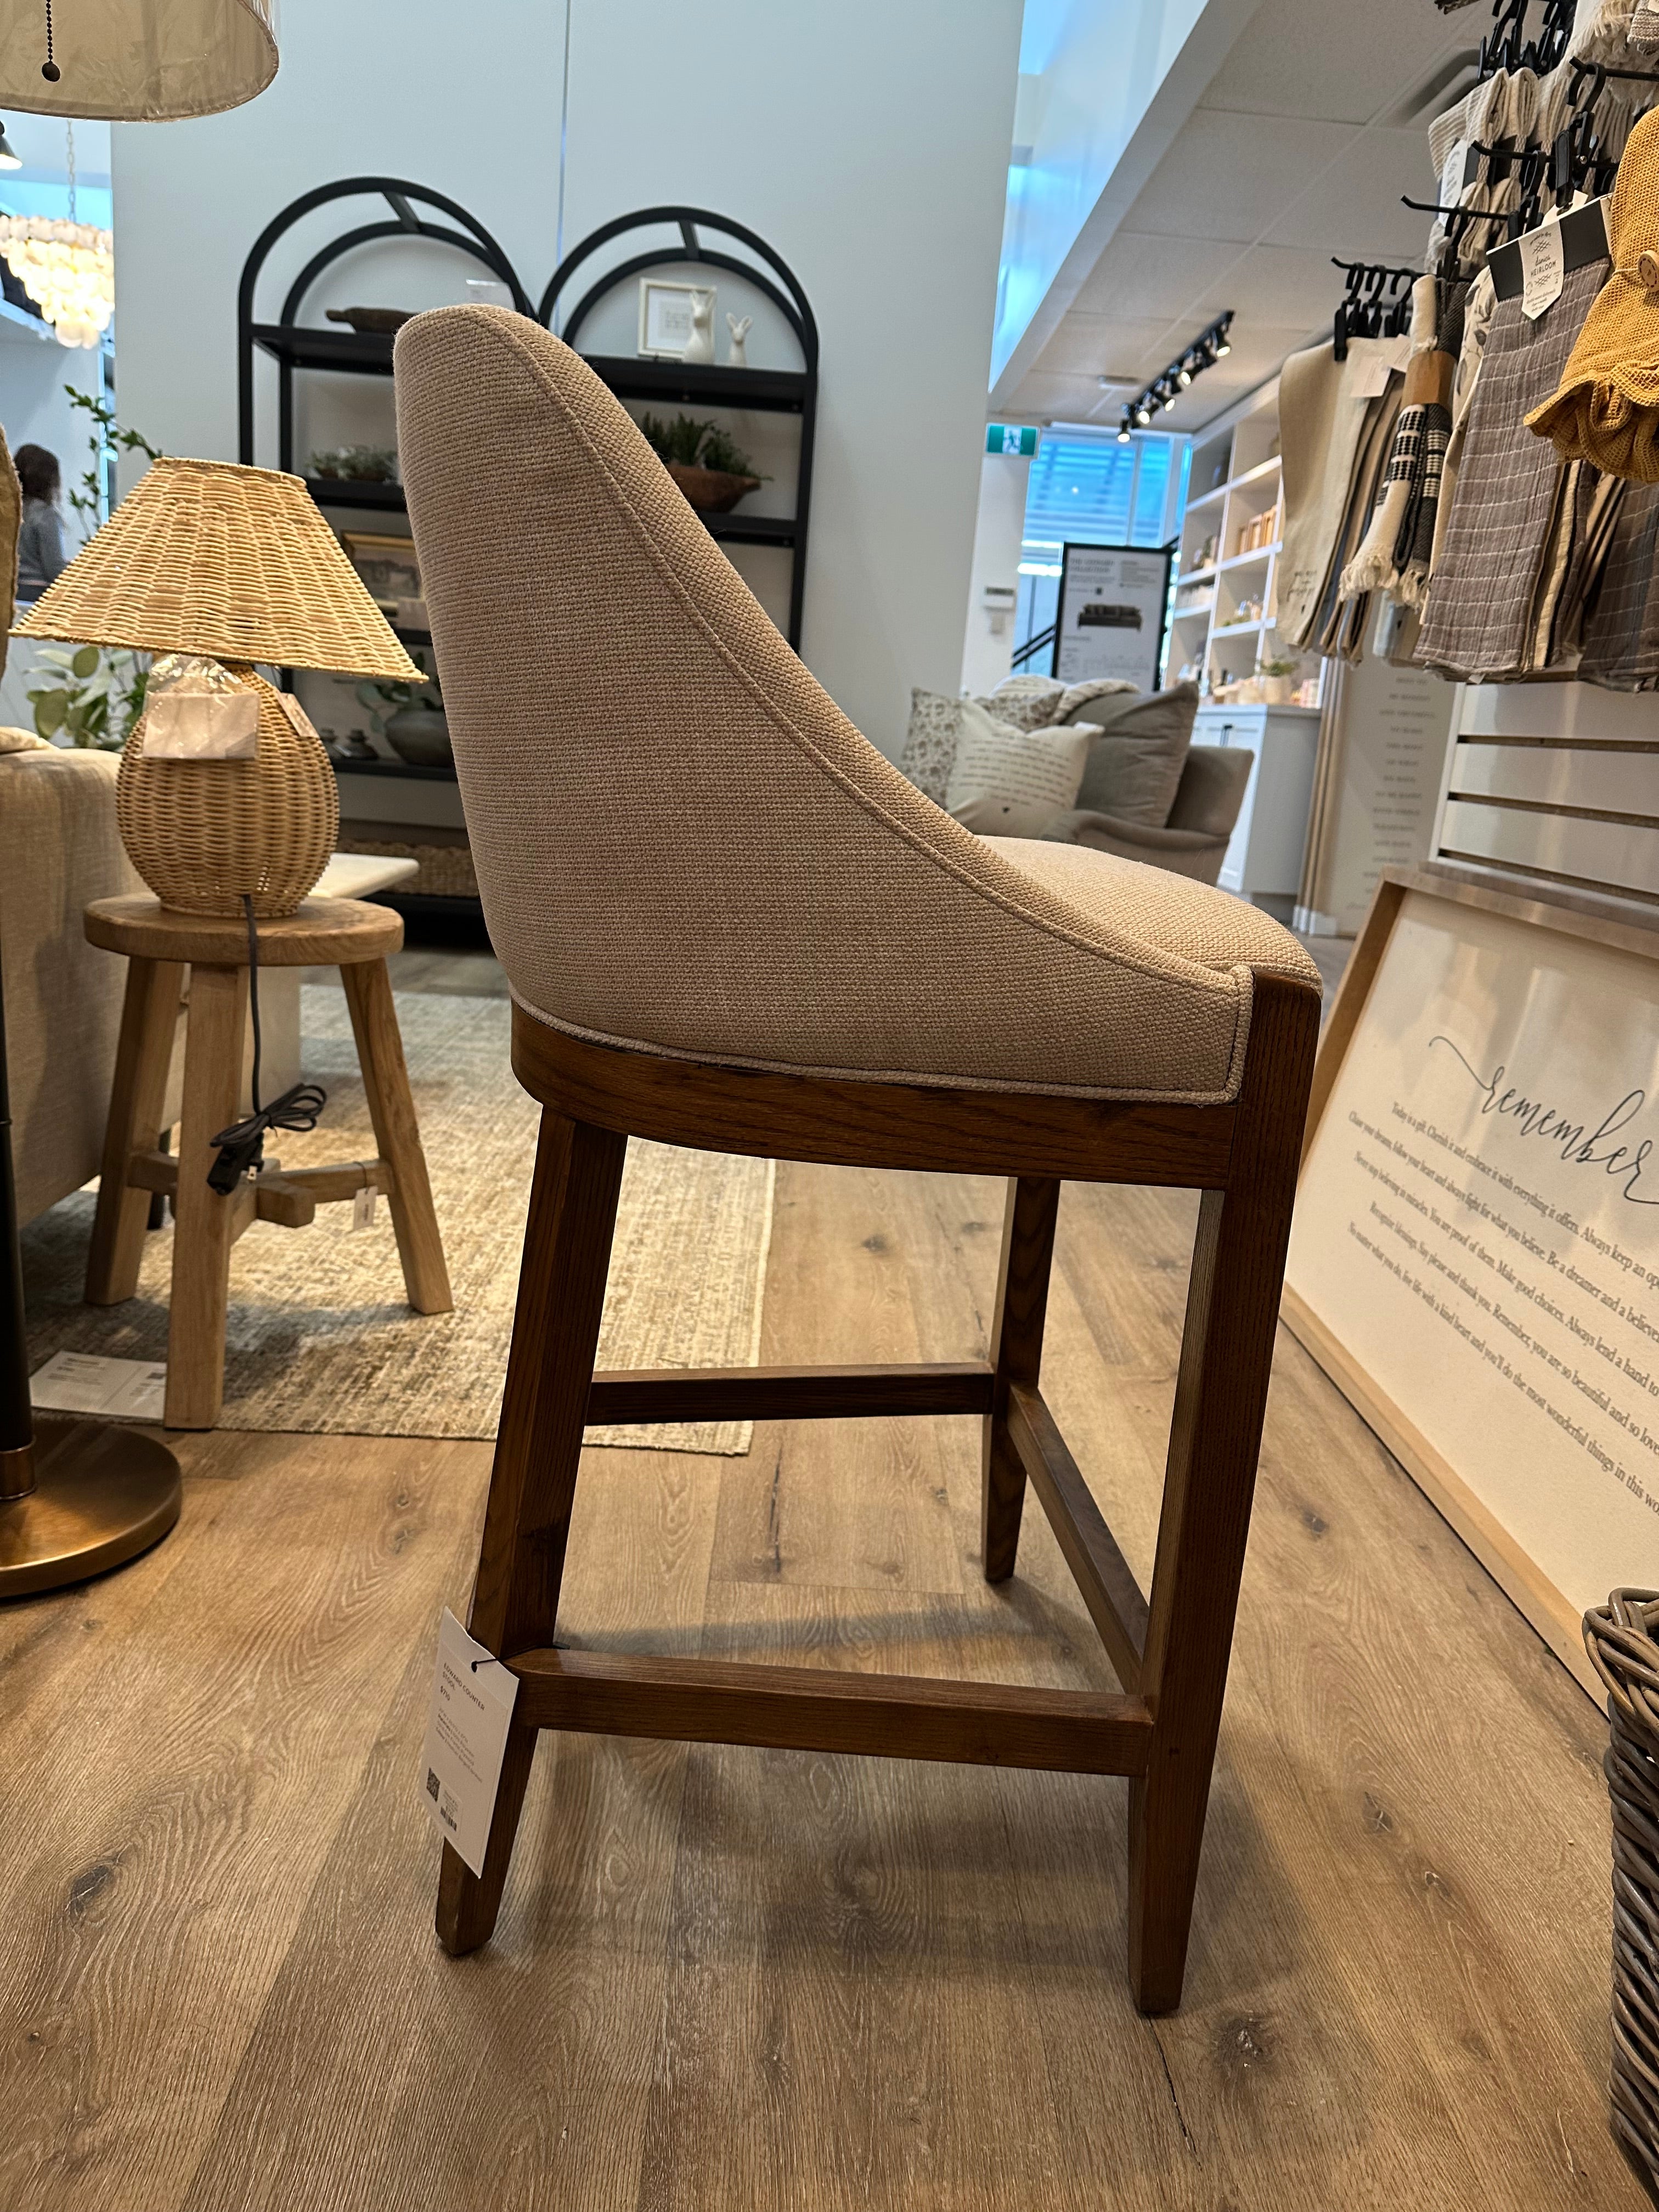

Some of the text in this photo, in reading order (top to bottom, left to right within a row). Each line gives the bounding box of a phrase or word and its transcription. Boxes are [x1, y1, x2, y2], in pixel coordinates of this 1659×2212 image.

[1531, 260, 1556, 277] HEIRLOOM
[1427, 1125, 1448, 1147] Cherish
[1448, 1138, 1454, 1150] it
[1453, 1147, 1466, 1159] and
[1465, 1155, 1492, 1176] embrace
[1492, 1167, 1498, 1180] it
[1498, 1174, 1513, 1190] with
[1513, 1186, 1549, 1217] everything
[1548, 1204, 1556, 1218] it
[1581, 1227, 1611, 1255] Always
[1610, 1245, 1632, 1272] keep
[1632, 1264, 1645, 1278] an
[1429, 1035, 1659, 1204] remember
[1392, 1141, 1408, 1159] follow
[1408, 1155, 1420, 1168] your
[1420, 1160, 1435, 1179] heart
[1435, 1175, 1448, 1187] and
[1446, 1181, 1465, 1201] always
[1465, 1193, 1481, 1211] fight
[1480, 1203, 1491, 1218] for
[1491, 1214, 1508, 1231] what
[1506, 1226, 1520, 1240] you
[1547, 1251, 1559, 1268] Be
[1559, 1264, 1566, 1273] a
[1566, 1266, 1602, 1297] dreamer
[1600, 1294, 1621, 1312] and
[1618, 1306, 1626, 1317] a
[1430, 1207, 1441, 1226] You
[1441, 1221, 1451, 1233] are
[1449, 1228, 1470, 1246] proof
[1469, 1242, 1479, 1252] of
[1496, 1260, 1516, 1284] Make
[1515, 1280, 1536, 1299] good
[1565, 1316, 1595, 1346] Always
[1595, 1336, 1617, 1362] lend
[1615, 1357, 1622, 1368] a
[1622, 1358, 1650, 1388] hand
[1649, 1381, 1659, 1396] to
[1440, 1304, 1455, 1324] kind
[1454, 1316, 1471, 1340] heart
[1470, 1336, 1486, 1352] and
[1482, 1348, 1504, 1370] you'll
[1503, 1363, 1513, 1379] do
[1511, 1373, 1527, 1391] the
[1526, 1387, 1547, 1409] most
[1547, 1404, 1589, 1446] wonderful
[1587, 1440, 1615, 1472] things
[1614, 1462, 1626, 1482] in
[1626, 1475, 1644, 1499] this
[1447, 1269, 1461, 1284] and
[1459, 1278, 1478, 1300] thank
[1530, 1341, 1548, 1359] you
[1548, 1355, 1562, 1370] are
[1561, 1367, 1571, 1379] so
[1571, 1370, 1611, 1411] beautiful
[1609, 1407, 1630, 1431] and
[1628, 1423, 1640, 1437] so
[462, 1685, 485, 1711] COUNTER
